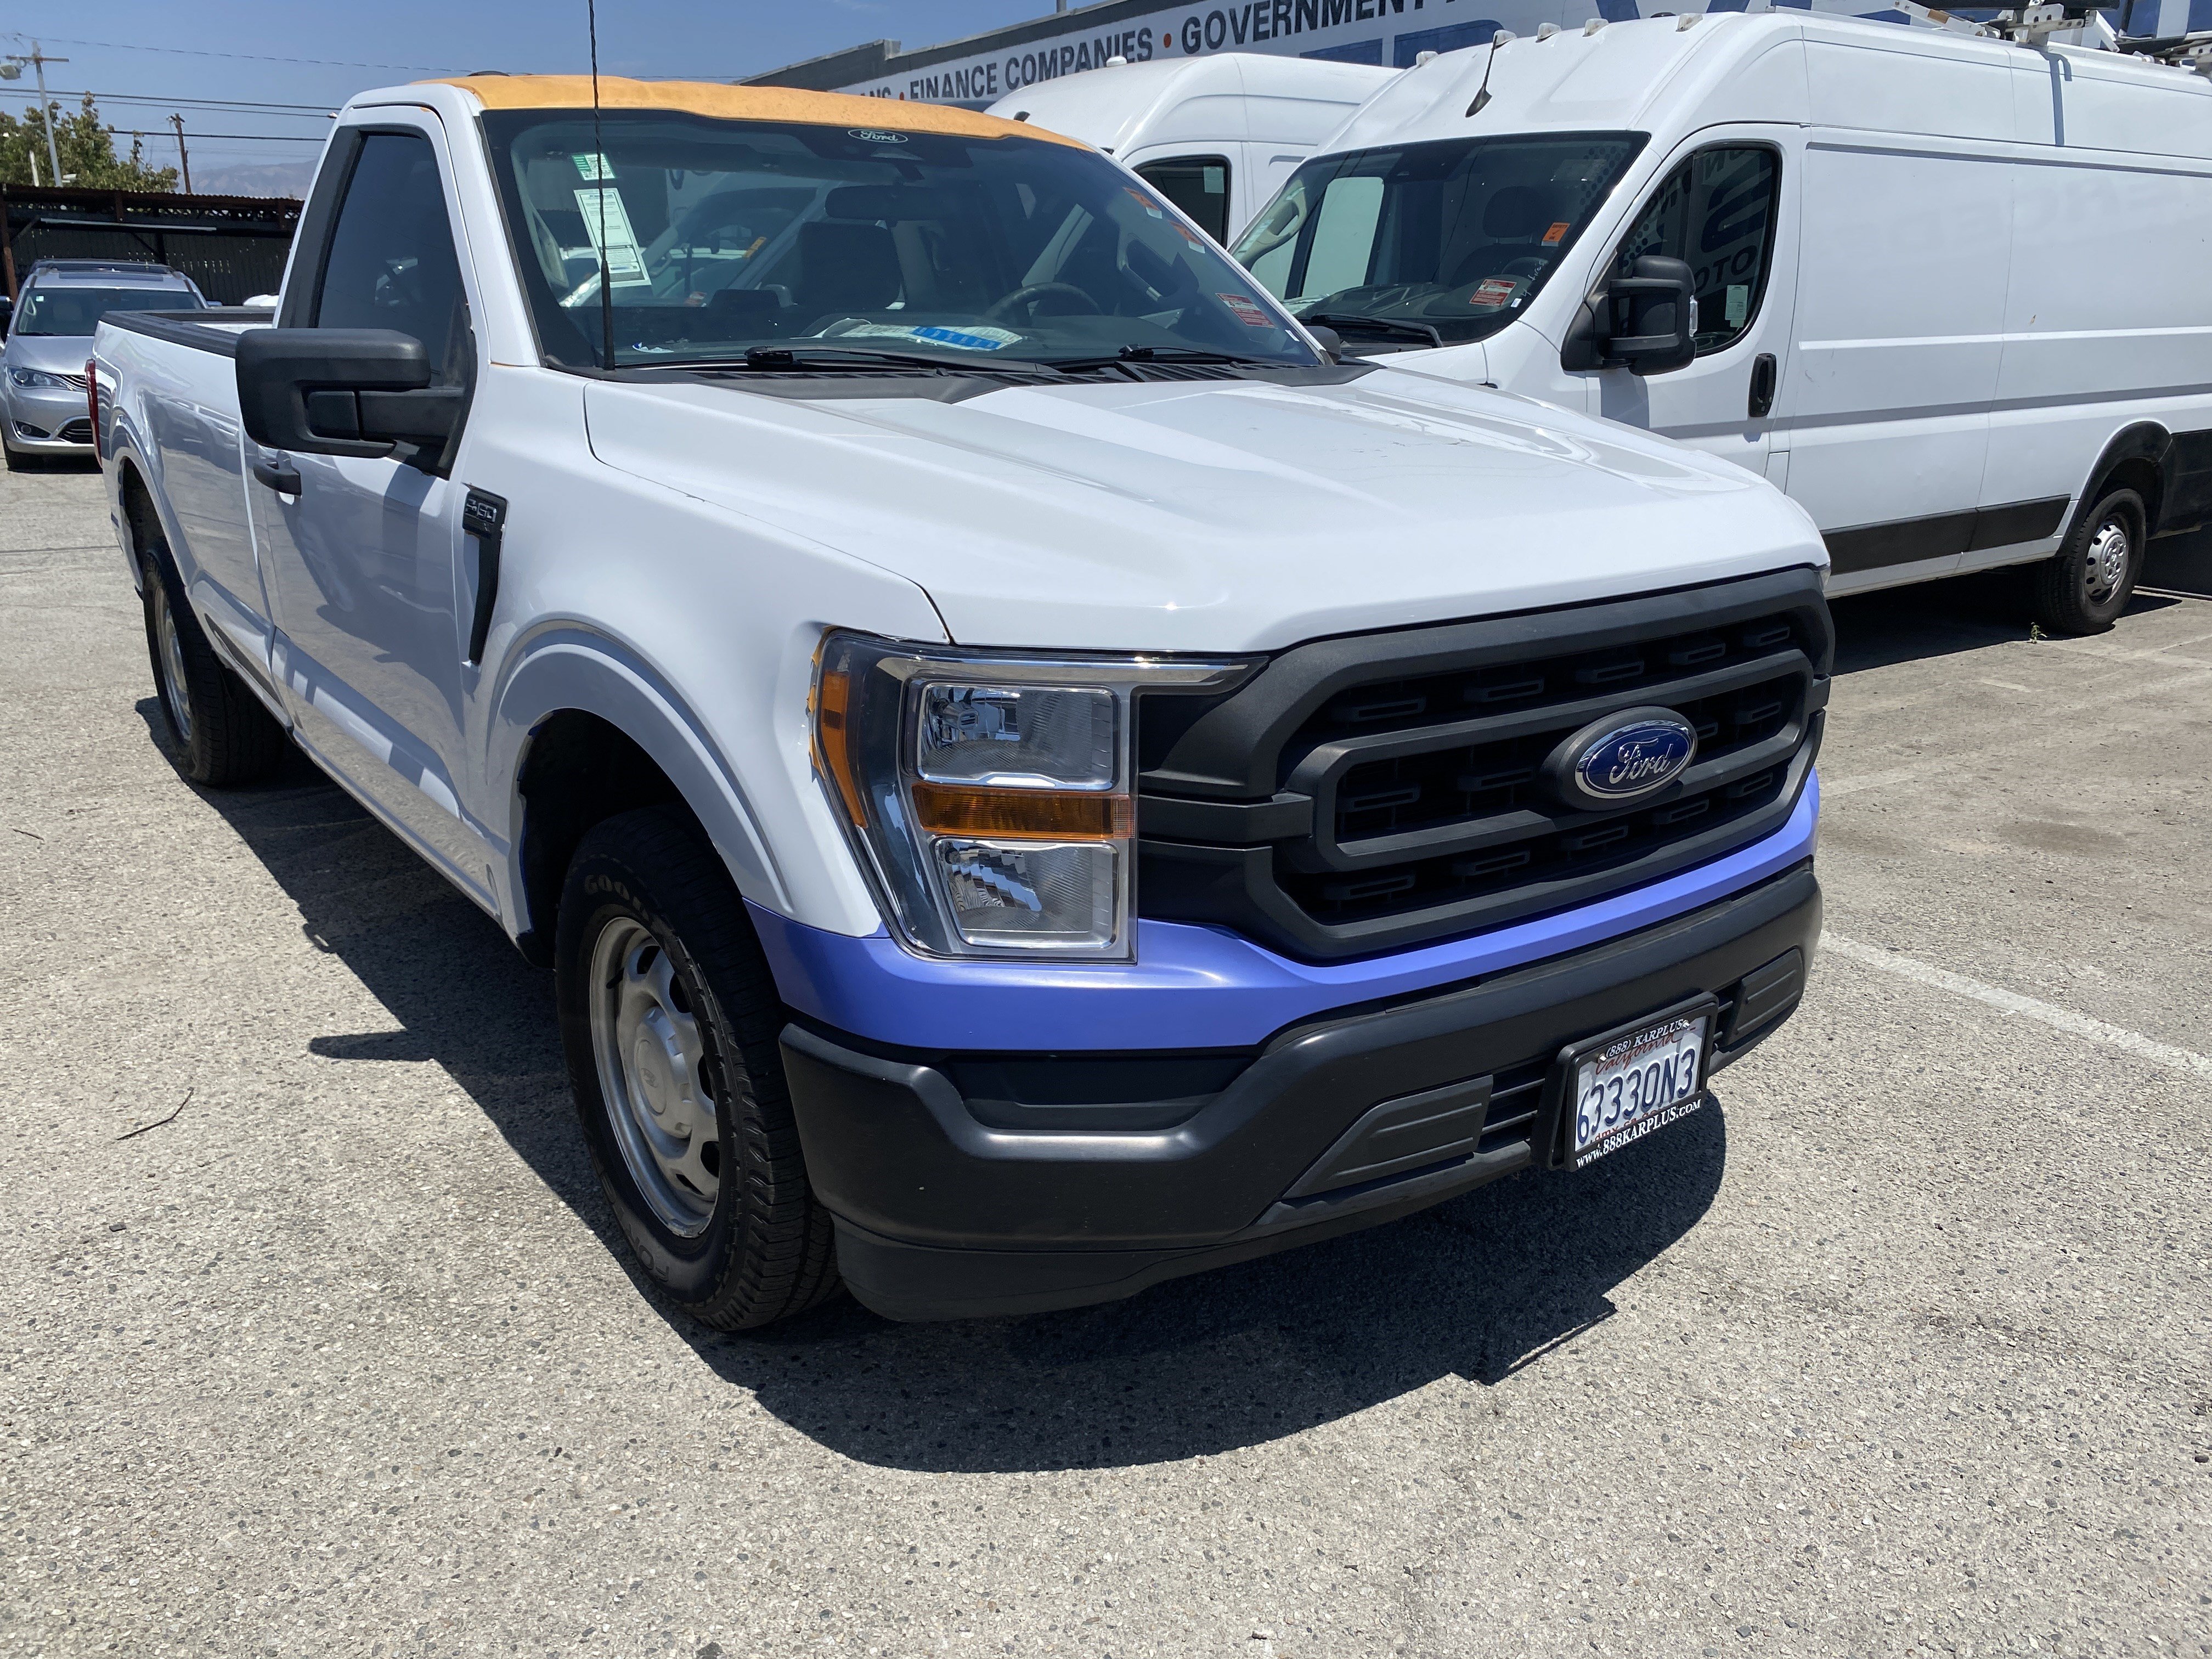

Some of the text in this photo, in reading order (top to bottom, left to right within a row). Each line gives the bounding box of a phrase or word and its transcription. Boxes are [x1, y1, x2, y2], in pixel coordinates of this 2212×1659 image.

[910, 62, 997, 99] FINANCE
[1005, 27, 1152, 90] COMPANIES
[860, 130, 898, 142] Ford
[1609, 738, 1674, 785] Ford
[1606, 1018, 1684, 1058] (888) KARPLUS
[1577, 1048, 1695, 1144] 63330N3
